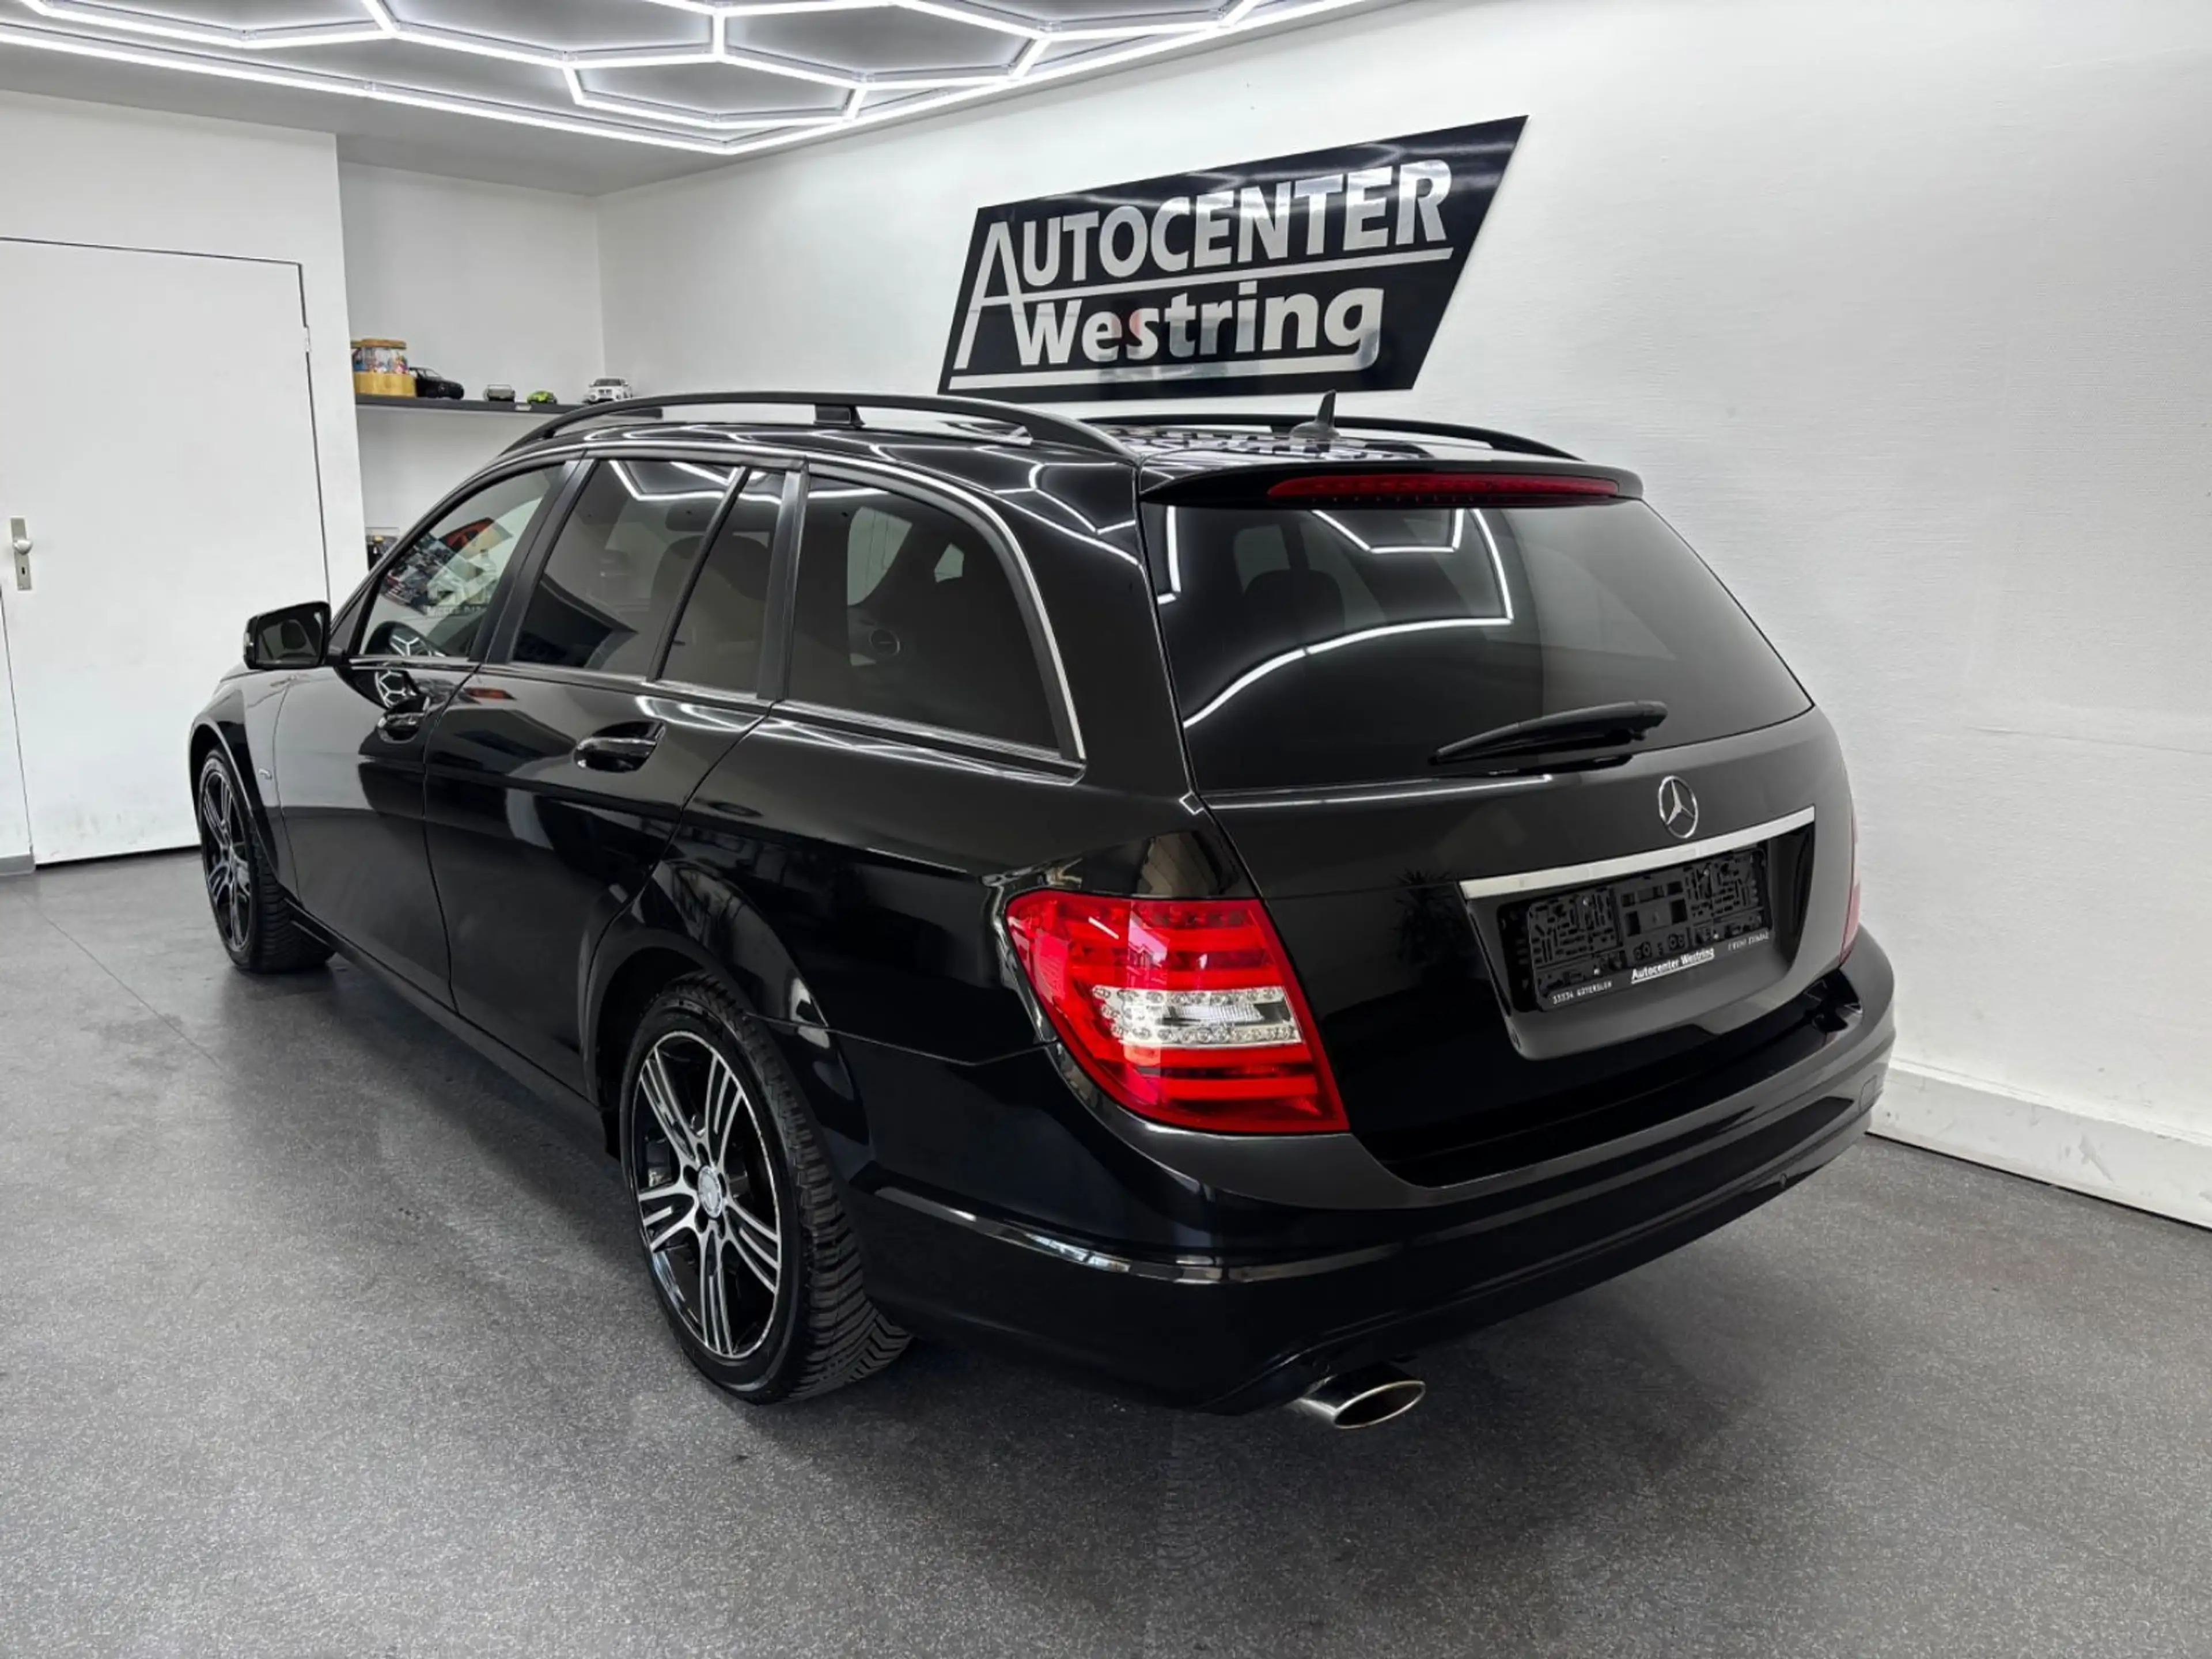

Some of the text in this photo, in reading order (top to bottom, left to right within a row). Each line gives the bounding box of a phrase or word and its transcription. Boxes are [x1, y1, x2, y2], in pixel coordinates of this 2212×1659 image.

[953, 158, 1452, 369] AUTOCENTER
[1021, 281, 1384, 372] Westring
[1631, 959, 1679, 980] Autocenter
